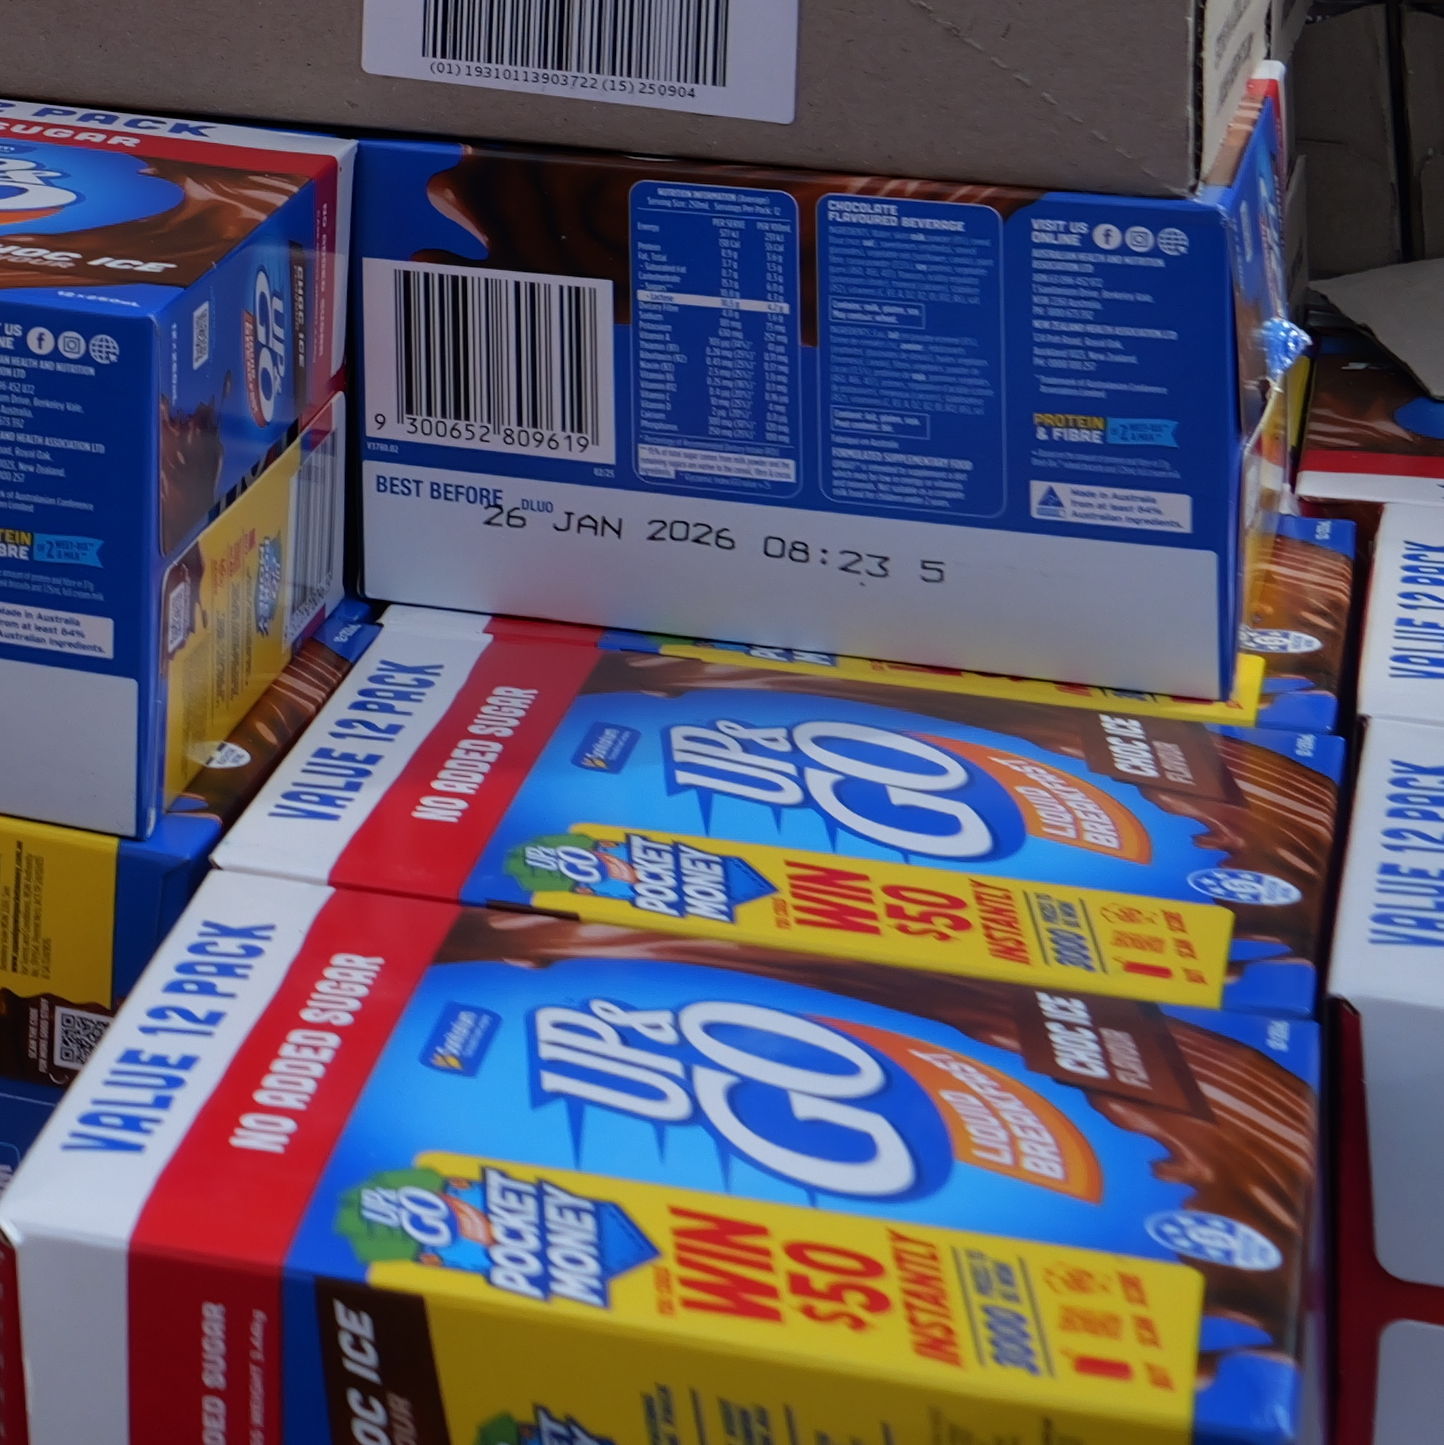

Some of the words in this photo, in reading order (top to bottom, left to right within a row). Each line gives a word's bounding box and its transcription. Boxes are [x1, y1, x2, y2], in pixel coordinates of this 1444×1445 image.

[35, 107, 224, 139] PACK
[87, 256, 179, 274] ICE
[162, 919, 276, 1000] PACK
[299, 951, 385, 1026] SUGAR
[139, 1003, 226, 1042] 12
[61, 1046, 200, 1154] VALUE
[253, 1028, 342, 1110] ADDED
[678, 999, 916, 1197] GO
[229, 1109, 298, 1154] NO
[907, 1045, 1066, 1182] BREAKFAST
[939, 1088, 1014, 1166] LIQUID
[483, 1166, 545, 1299] POCKET
[536, 1178, 609, 1307] MONEY
[669, 1203, 785, 1326] WIN
[784, 1240, 893, 1334] $50
[885, 1225, 964, 1371] INSTANTLY
